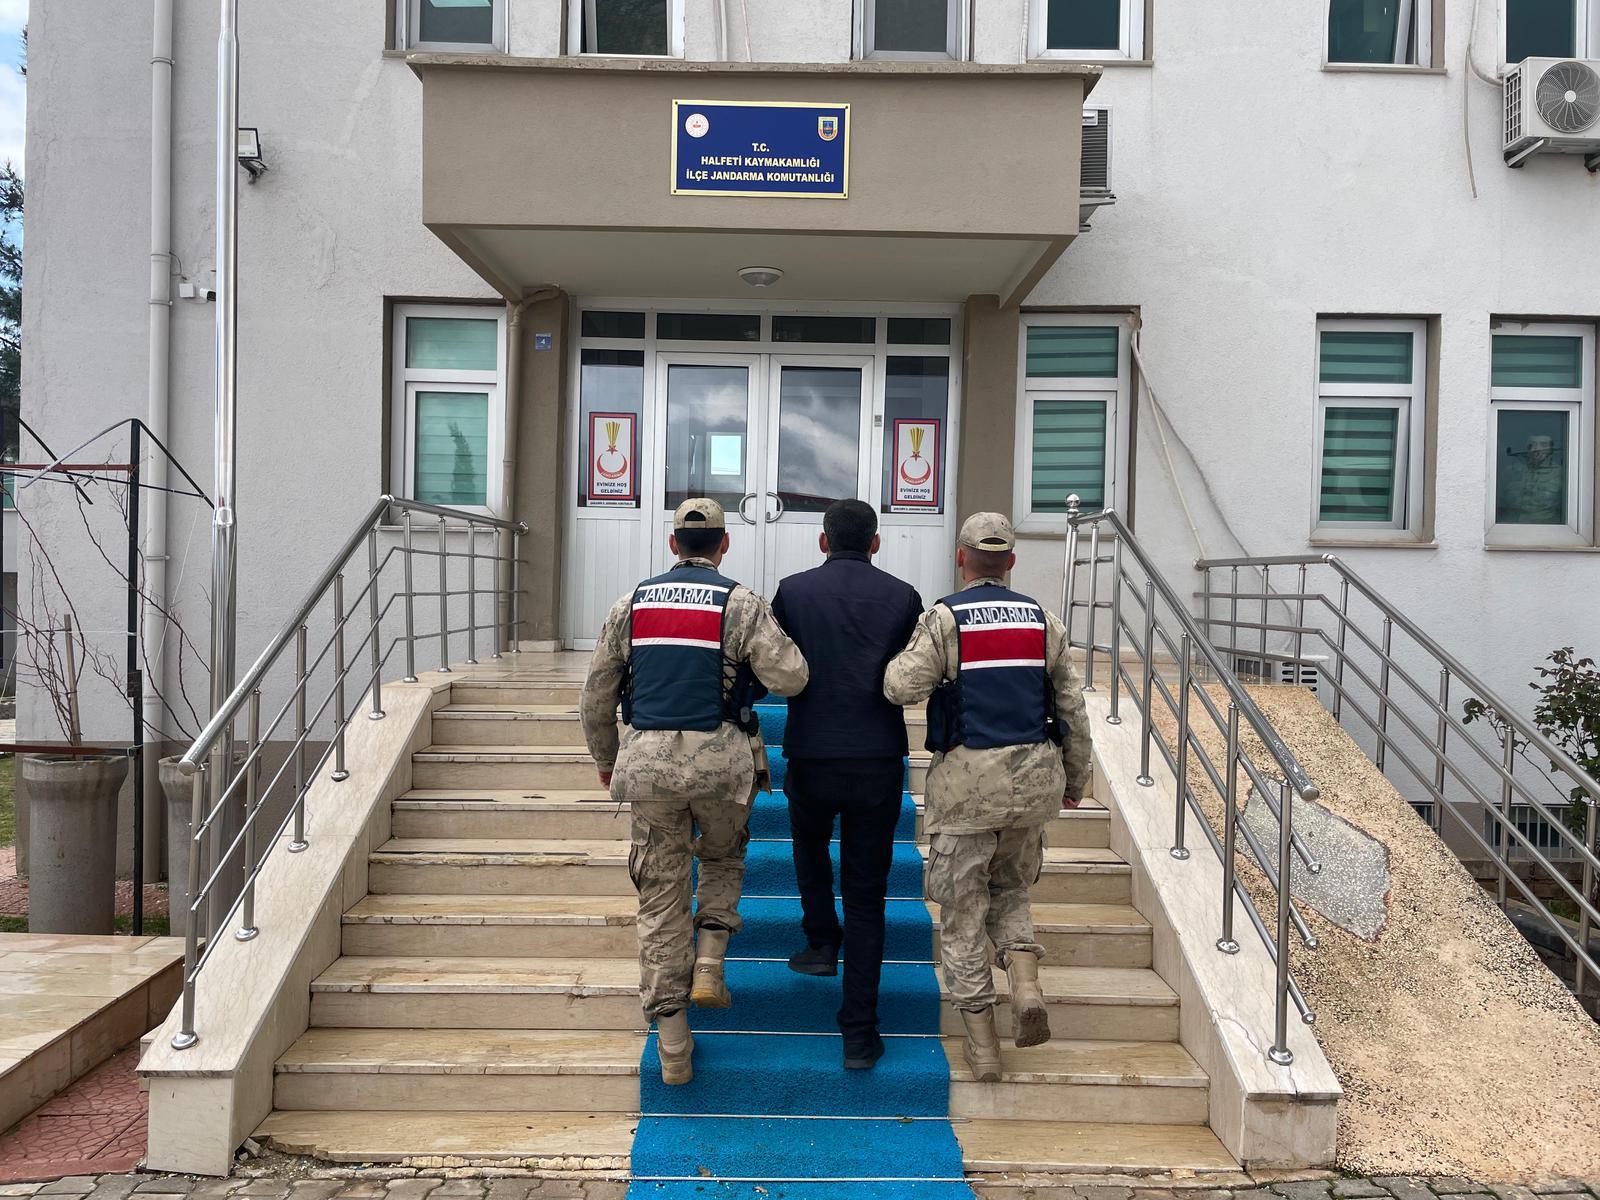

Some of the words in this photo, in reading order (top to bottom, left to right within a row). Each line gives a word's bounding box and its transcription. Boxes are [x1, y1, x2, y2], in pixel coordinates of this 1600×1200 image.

[751, 142, 770, 152] T.C.
[700, 155, 742, 166] HALFETİ
[744, 156, 820, 168] KAYMAKAMLIĞI
[686, 169, 708, 182] İLÇE
[710, 171, 764, 181] JANDARMA
[766, 172, 835, 183] KOMUTANLIĞI
[640, 587, 714, 605] JANDARMA
[965, 607, 1038, 625] JANDARMA
